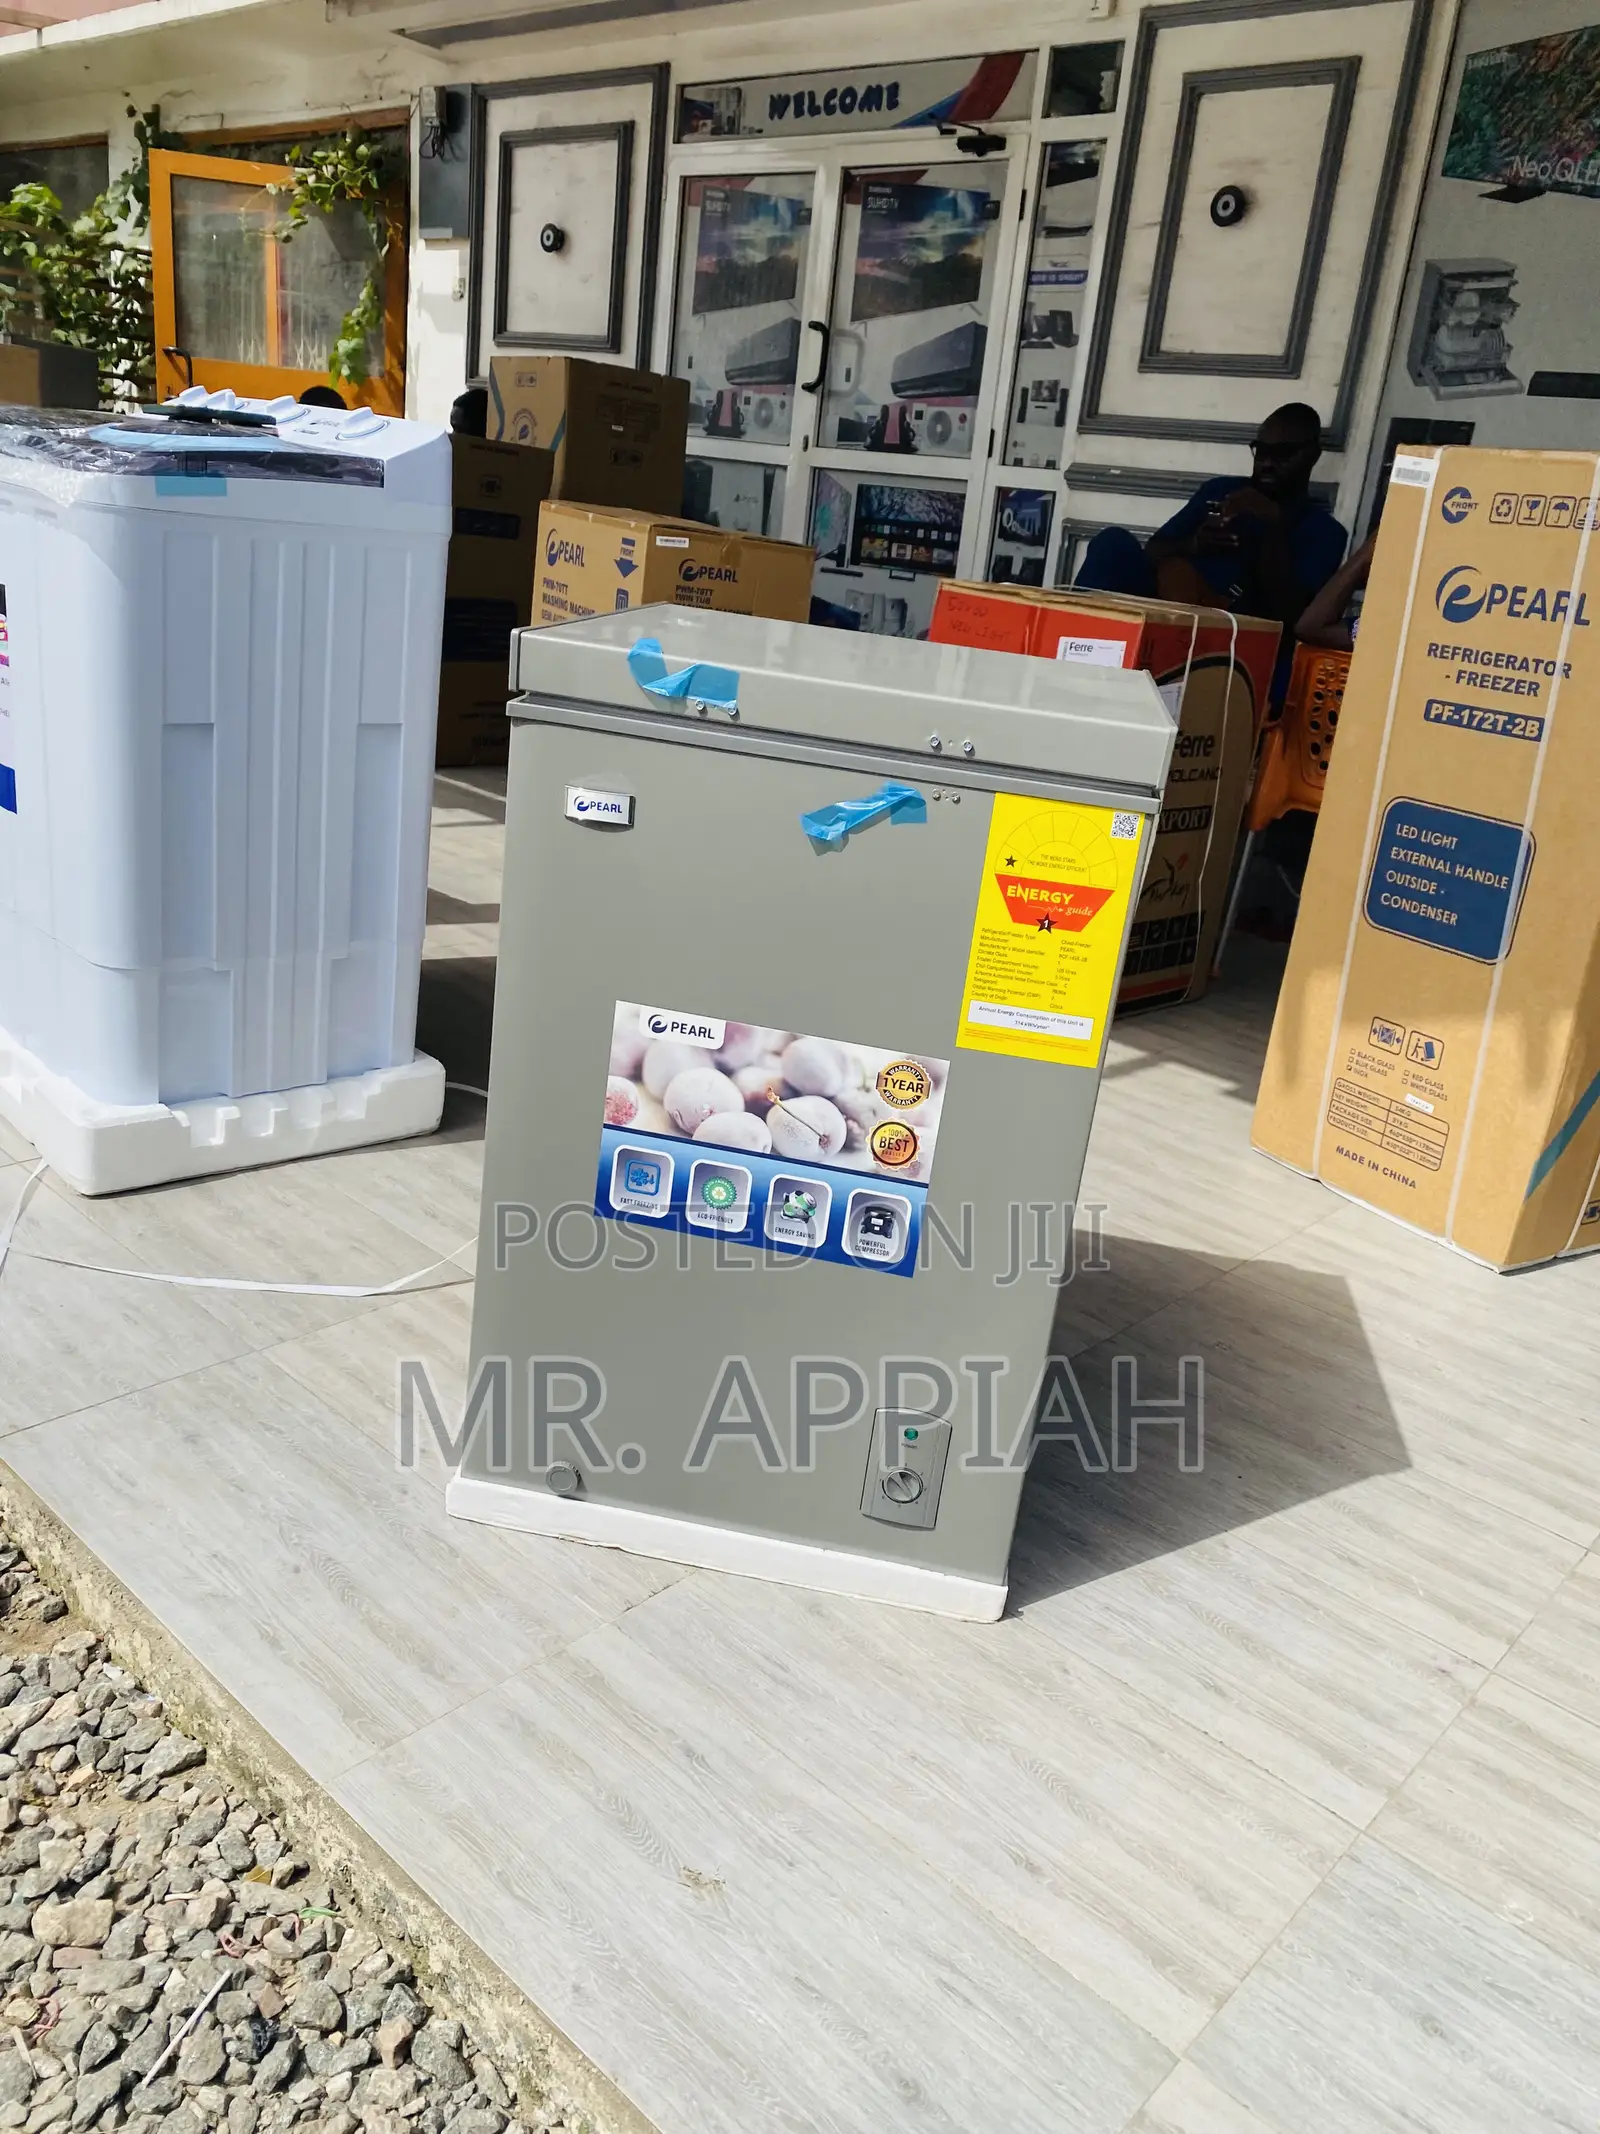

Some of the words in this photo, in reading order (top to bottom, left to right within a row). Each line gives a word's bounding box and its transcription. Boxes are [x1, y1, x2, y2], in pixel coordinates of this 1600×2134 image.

[768, 81, 900, 121] WELCOME
[1508, 155, 1550, 180] Neo
[1555, 157, 1600, 184] QLE
[1451, 500, 1480, 511] FRONT
[559, 540, 585, 568] PEARL
[620, 547, 634, 558] FRONT
[700, 566, 738, 583] PEARL
[542, 592, 568, 612] WASHING
[675, 593, 693, 602] TWIN
[696, 595, 712, 605] TUB
[1484, 583, 1591, 627] PEARL
[1069, 641, 1094, 653] Ferre
[1427, 642, 1572, 679] REFRIGERATOR
[1455, 669, 1541, 698] FREEZER
[1429, 702, 1541, 738] PF-172T-2B
[590, 801, 622, 814] PEARL
[1396, 823, 1418, 839] LED
[1421, 830, 1458, 850] LIGHT
[1049, 862, 1066, 871] ENERGY
[1050, 855, 1062, 863] MORE
[1390, 847, 1451, 875] EXTERNAL
[1455, 863, 1509, 890] HANDLE
[1386, 870, 1438, 895] OUTSIDE
[1006, 883, 1074, 904] ENERGY
[1065, 906, 1093, 916] guide
[1381, 892, 1458, 927] CONDENSER
[997, 1008, 1015, 1017] Energy
[1016, 1011, 1050, 1022] Consumption
[671, 1021, 715, 1039] PEARL
[1355, 1059, 1368, 1071] BLUE
[1369, 1064, 1388, 1077] GLASS
[1357, 1051, 1375, 1066] BLACK
[1376, 1058, 1396, 1071] GLASS
[888, 1065, 923, 1081] WARRANTY
[1353, 1068, 1368, 1079] INOX
[1412, 1072, 1423, 1083] RED
[1424, 1078, 1444, 1091] GLASS
[883, 1077, 888, 1087] 1
[891, 1079, 924, 1094] YEAR
[1337, 1081, 1357, 1094] GROSS
[1410, 1081, 1427, 1093] WHITE
[1428, 1087, 1448, 1102] GLASS
[883, 1089, 919, 1106] WARRANTY
[1332, 1103, 1360, 1121] PACKAGE
[1330, 1114, 1356, 1132] PRODUCT
[888, 1128, 906, 1138] 100%
[879, 1137, 910, 1152] BEST
[1336, 1145, 1365, 1165] MADE
[1368, 1159, 1379, 1172] IN
[1382, 1166, 1417, 1189] CHINA
[620, 1197, 633, 1205] FAST
[775, 1226, 795, 1238] ENERGY
[796, 1230, 816, 1240] SAVING
[855, 1245, 890, 1257] COMPRESSOR
[859, 1238, 887, 1250] POWERFUL
